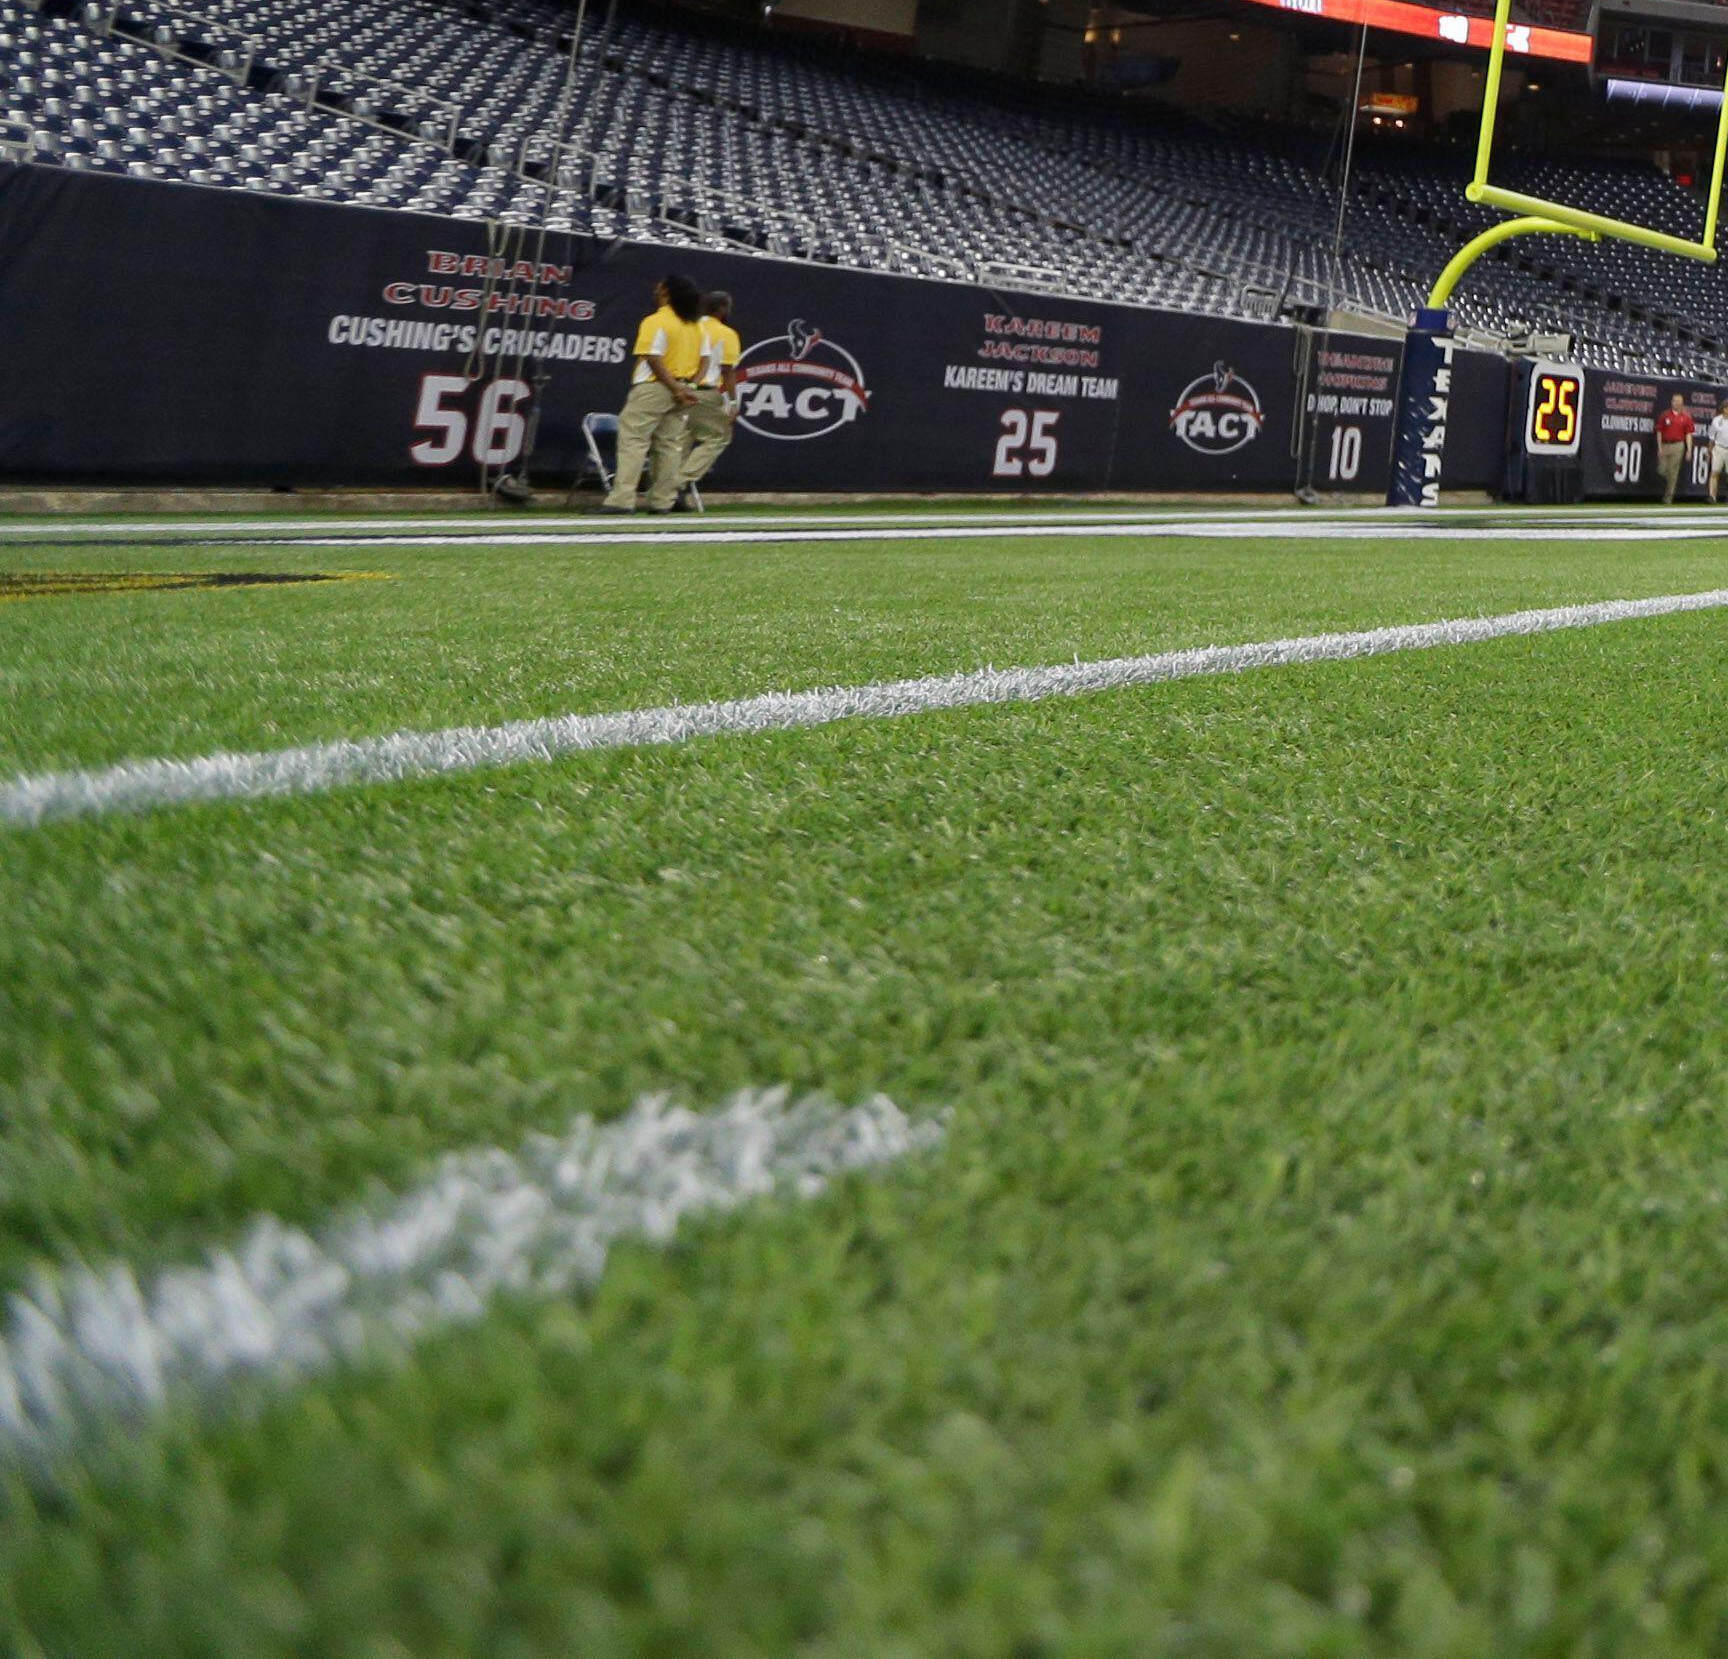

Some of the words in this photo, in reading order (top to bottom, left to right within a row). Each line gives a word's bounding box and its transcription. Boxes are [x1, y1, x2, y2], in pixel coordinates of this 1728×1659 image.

[427, 250, 573, 286] BRIAN
[383, 282, 597, 321] CUSHING
[328, 315, 477, 353] CUSHING'S
[482, 327, 629, 363] CRUSADERS
[984, 313, 1102, 344] KAREEM
[977, 340, 1099, 367] JACKSON
[944, 365, 1025, 392] KAREEM'S
[1026, 372, 1078, 397] DREAM
[1081, 377, 1119, 400] TEAM
[410, 373, 531, 466] 56
[1168, 407, 1265, 440] TACT
[1368, 399, 1395, 418] STOP
[1419, 336, 1454, 508] TEXANS
[1535, 378, 1575, 442] 25
[992, 408, 1060, 477] 25
[1328, 425, 1362, 481] 10
[1614, 440, 1642, 483] 90
